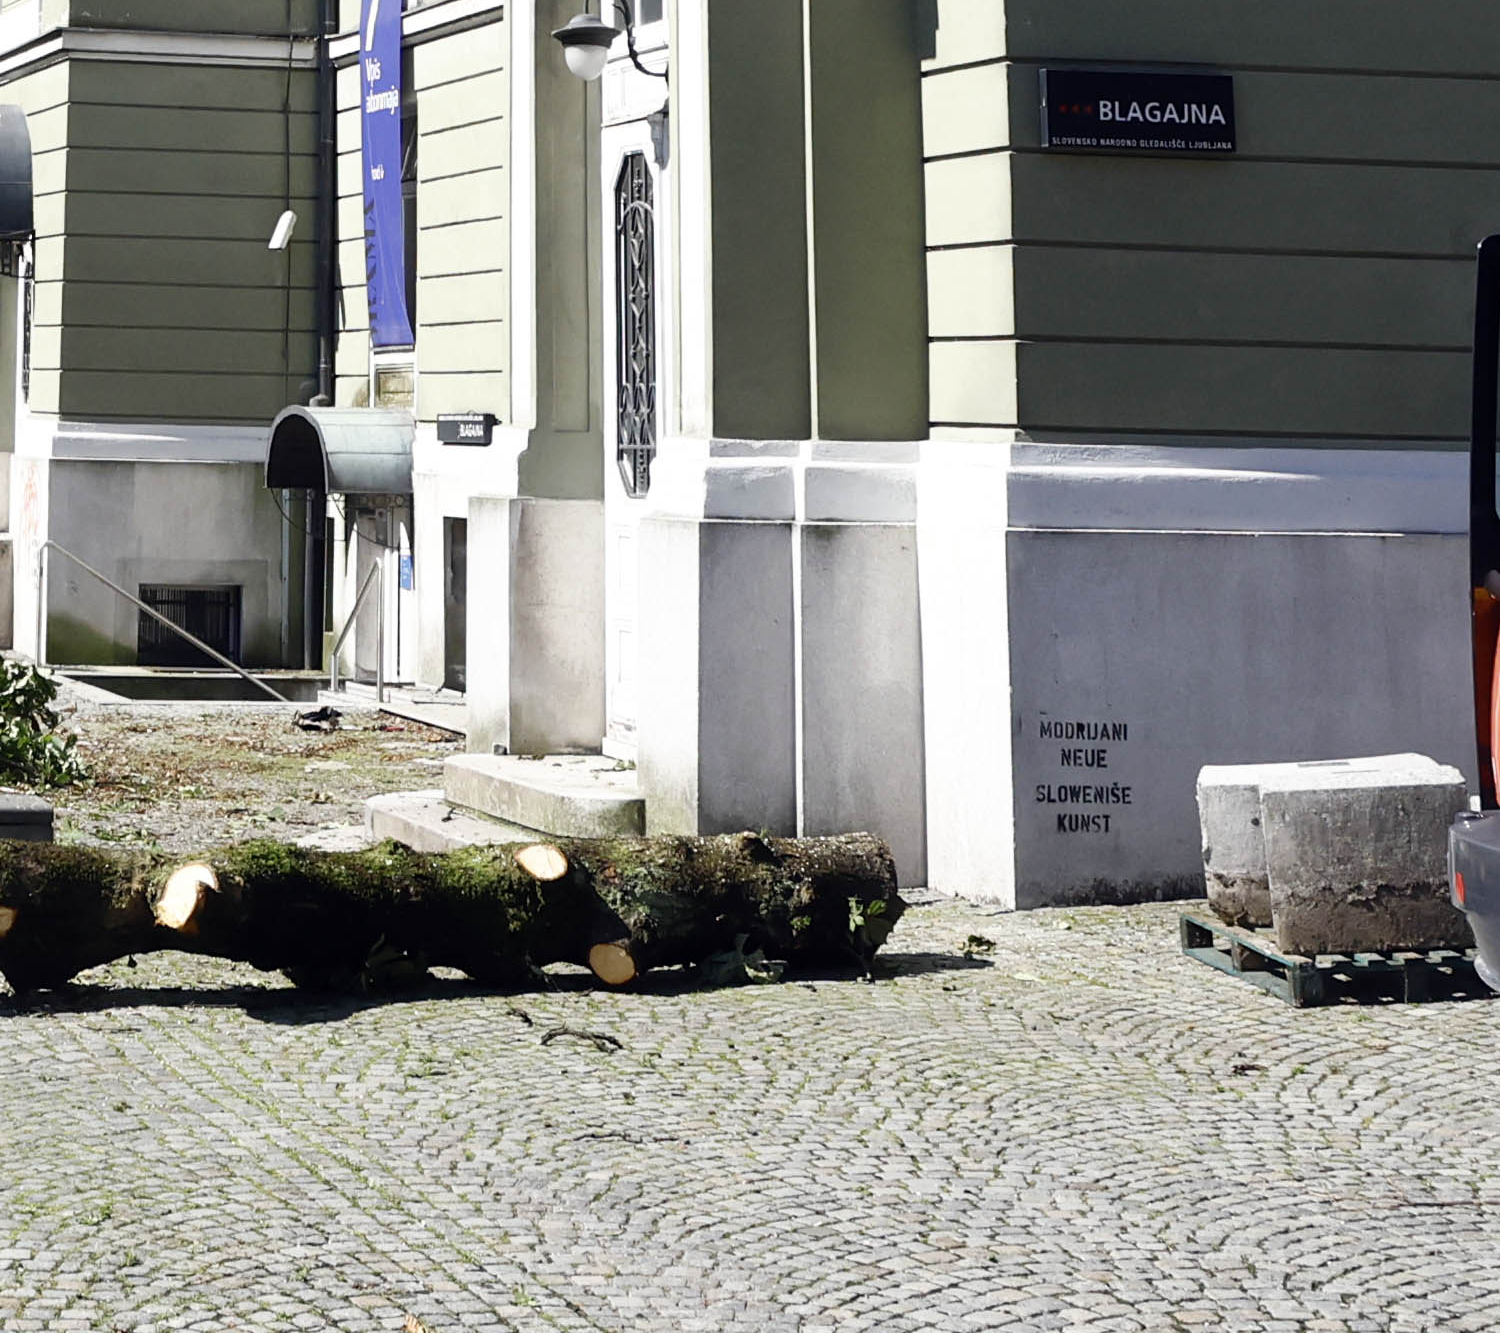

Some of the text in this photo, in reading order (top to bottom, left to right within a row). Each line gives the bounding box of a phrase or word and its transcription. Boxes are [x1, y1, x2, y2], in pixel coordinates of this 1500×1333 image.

[365, 57, 382, 89] Vpis
[1098, 100, 1227, 125] BLAGAJNA
[1051, 136, 1098, 147] SLOVENSKO
[1100, 137, 1138, 148] NARODNO
[1188, 139, 1233, 150] LJUBLJANA
[1040, 720, 1128, 742] MODRIJANI
[1060, 748, 1108, 768] NEUE
[1035, 781, 1132, 805] SLOWENIŠE
[1056, 813, 1112, 834] KUNST
